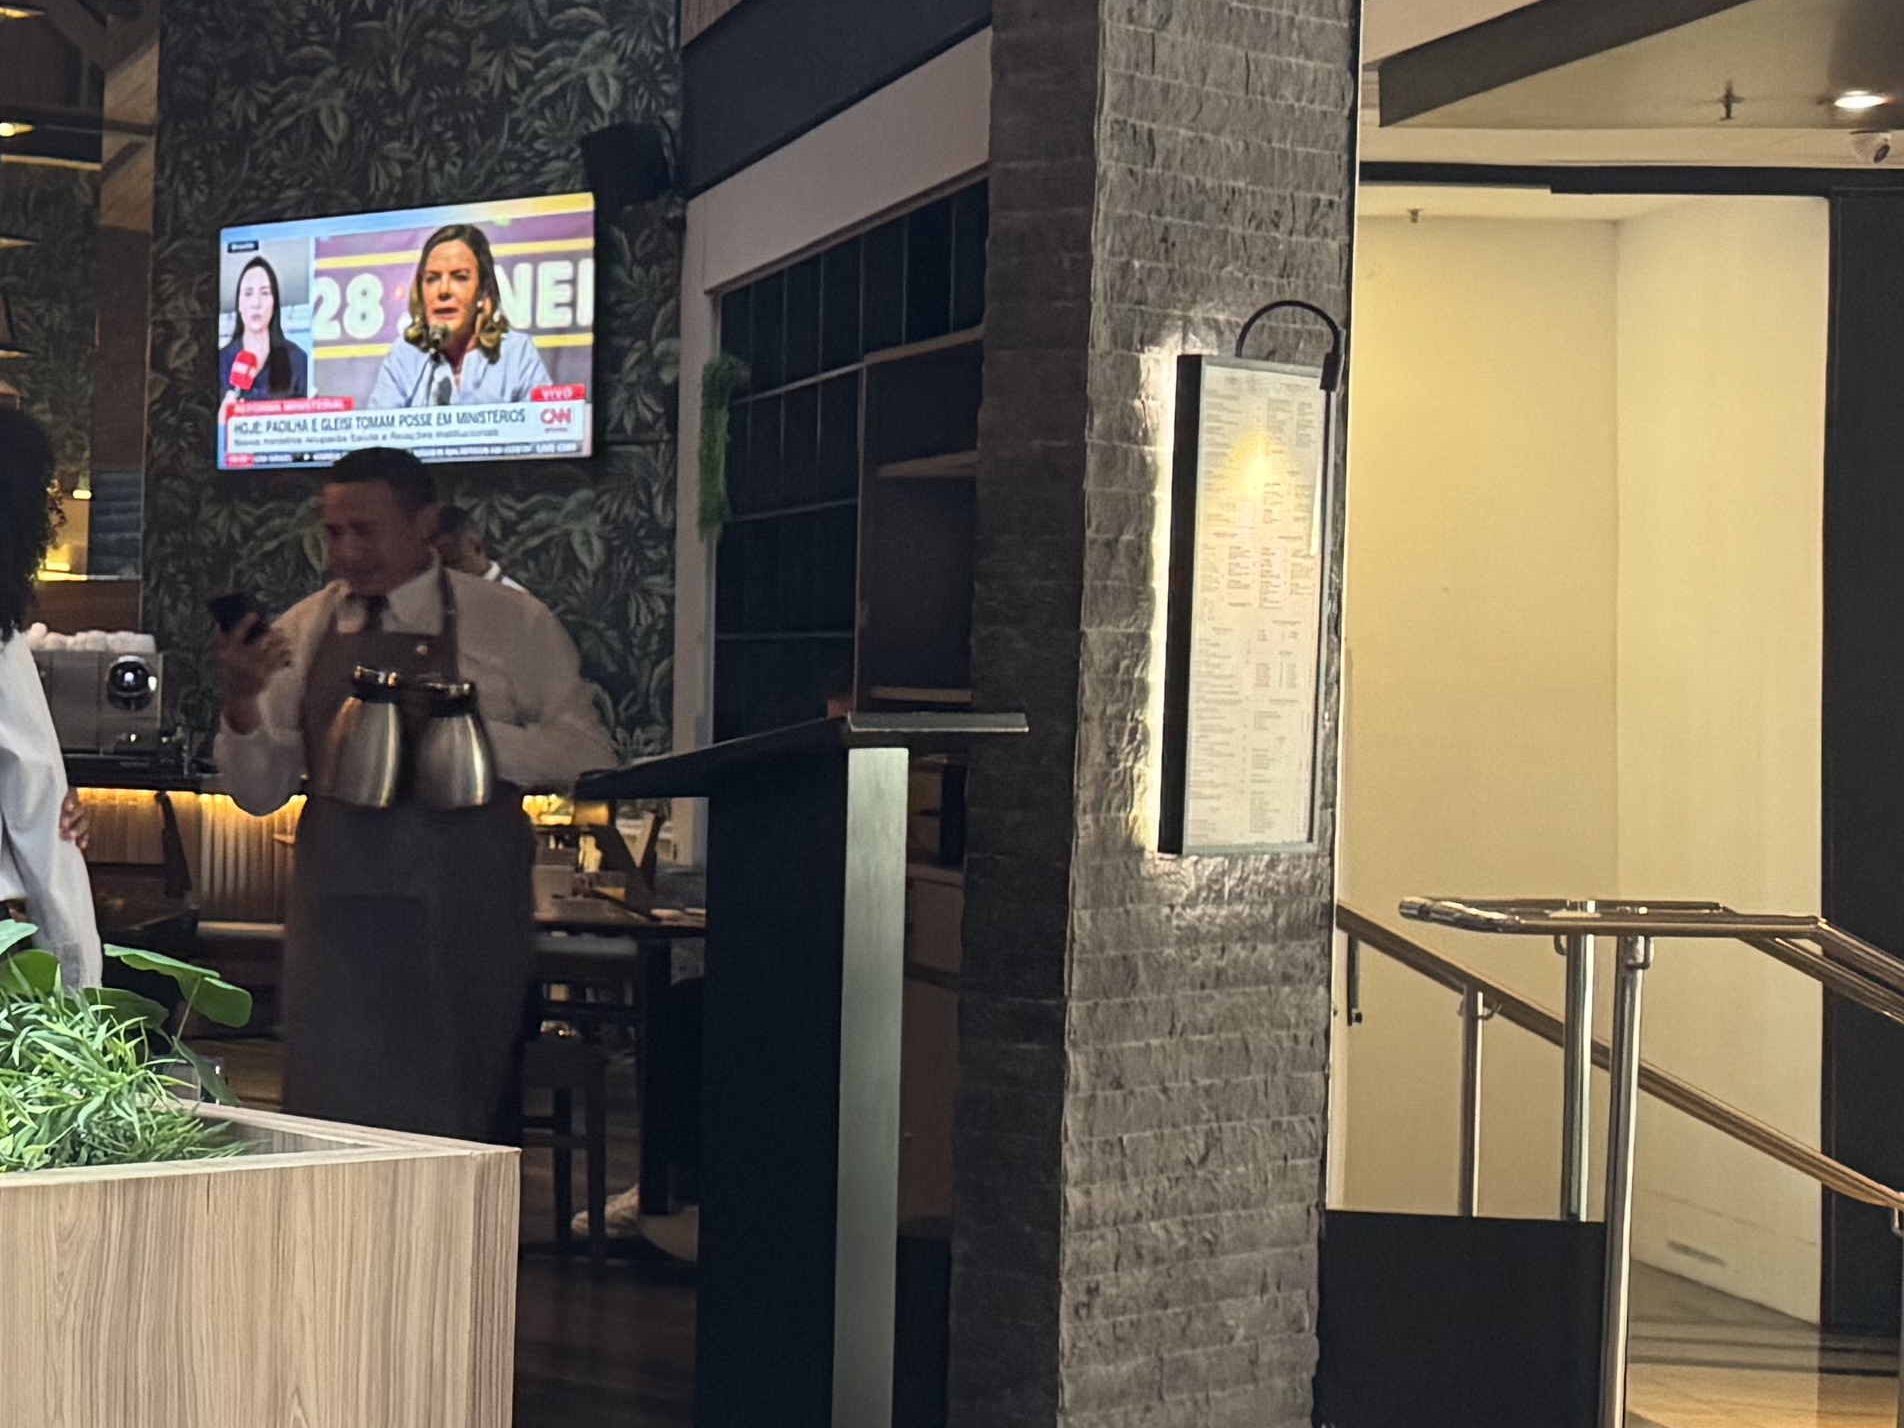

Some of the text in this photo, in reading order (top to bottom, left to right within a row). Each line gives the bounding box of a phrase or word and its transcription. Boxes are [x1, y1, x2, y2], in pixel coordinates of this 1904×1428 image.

[313, 273, 385, 341] 28
[540, 386, 574, 400] VIVO
[311, 417, 318, 432] E
[356, 414, 396, 430] TOMAM
[399, 411, 433, 427] POSSE
[436, 410, 452, 426] EM
[539, 407, 572, 424] CNN
